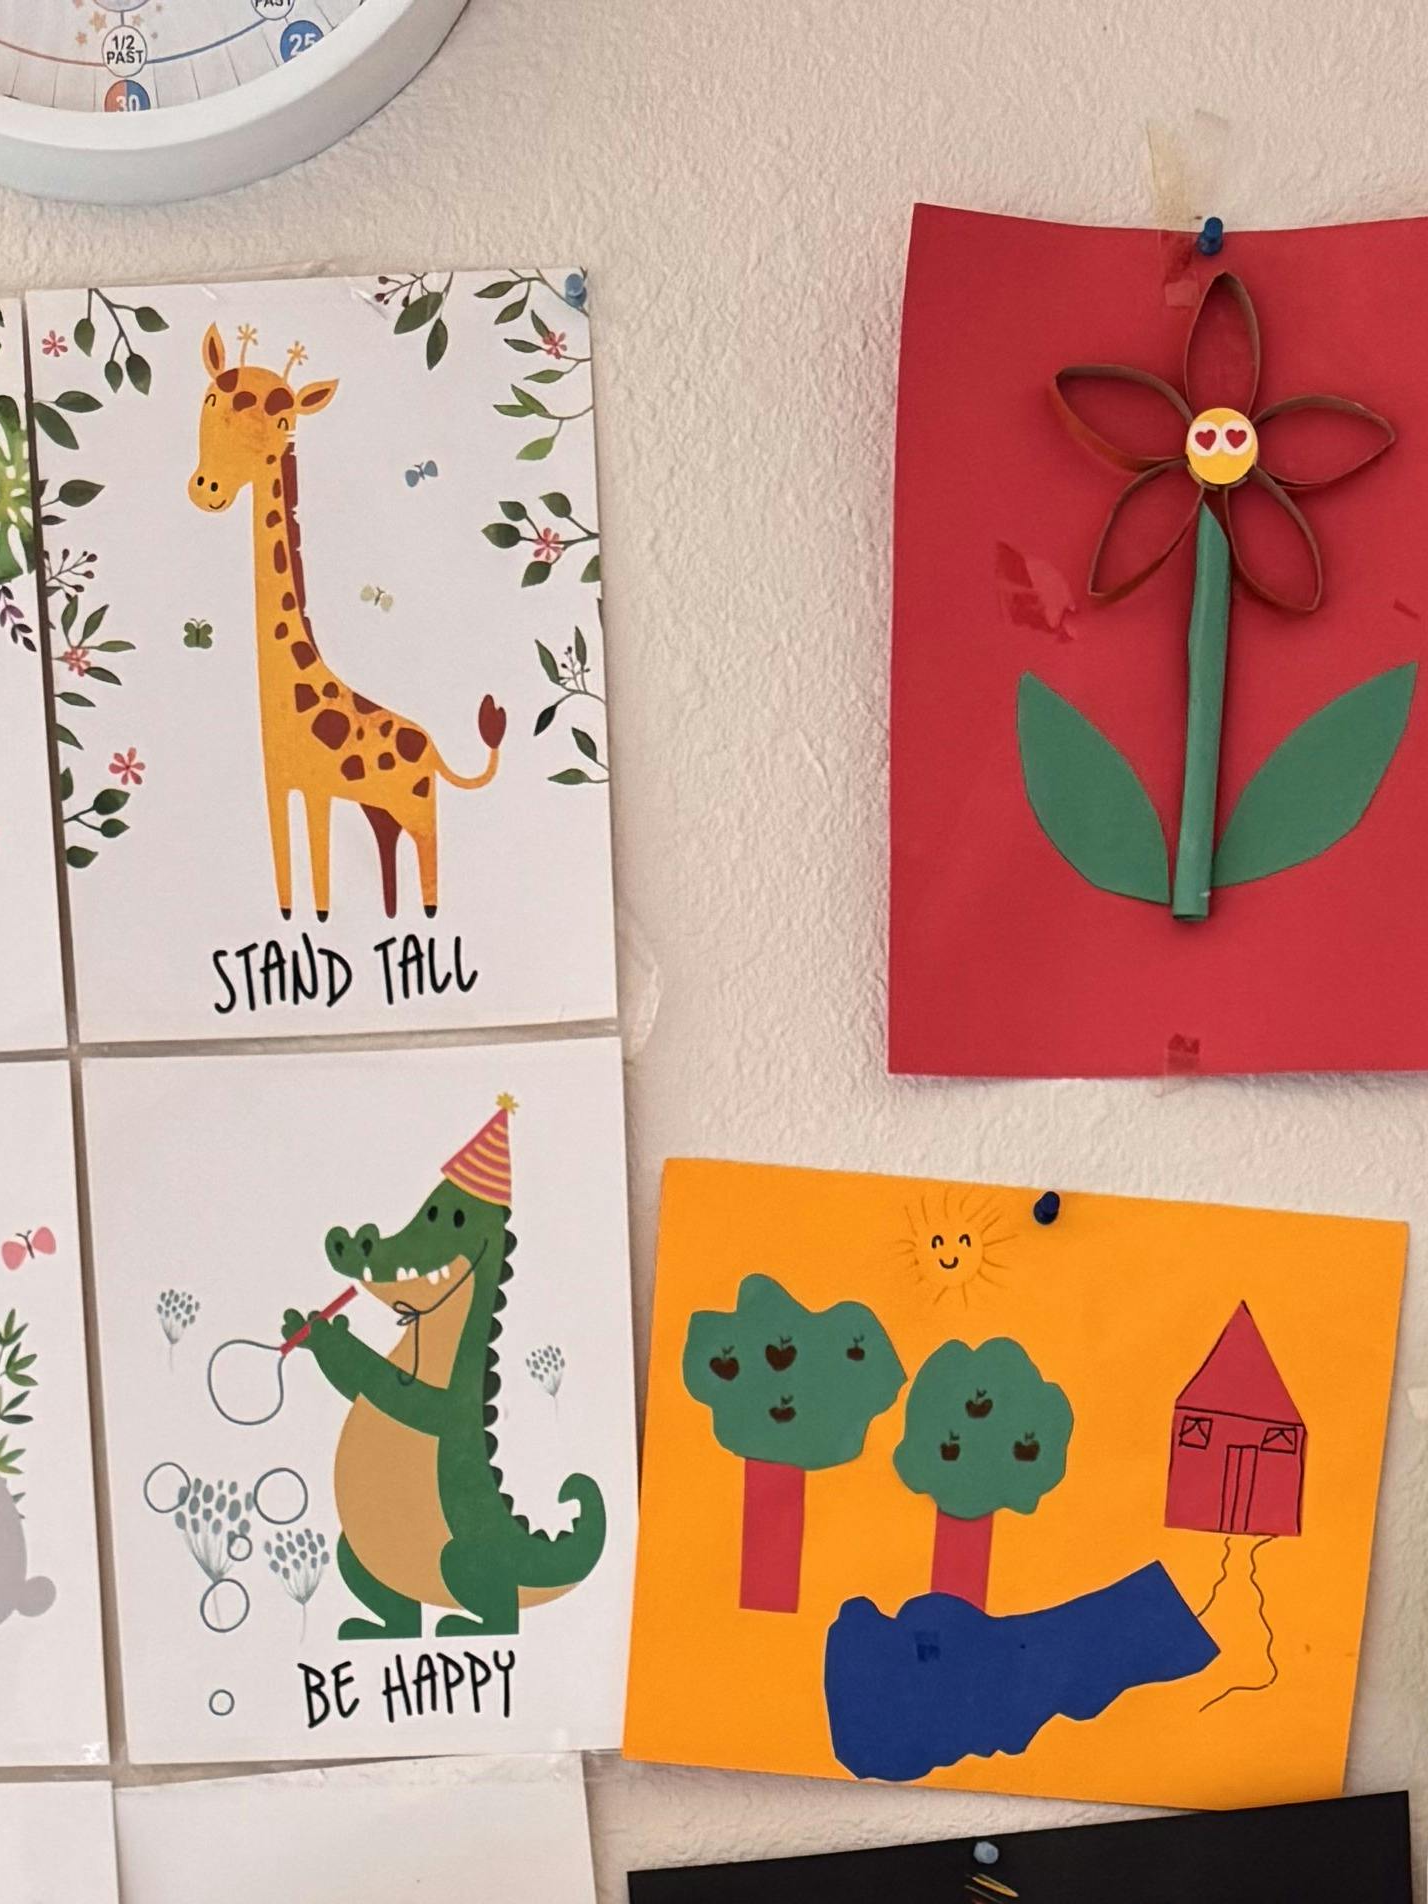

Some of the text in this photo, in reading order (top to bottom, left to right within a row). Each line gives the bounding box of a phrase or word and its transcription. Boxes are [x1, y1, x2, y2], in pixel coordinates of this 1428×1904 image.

[112, 34, 135, 50] 1/2
[288, 32, 318, 53] 25
[106, 49, 145, 65] PAST
[116, 94, 140, 111] 30
[209, 936, 478, 1017] STAND TALL
[297, 1649, 518, 1725] BE HAPPY
